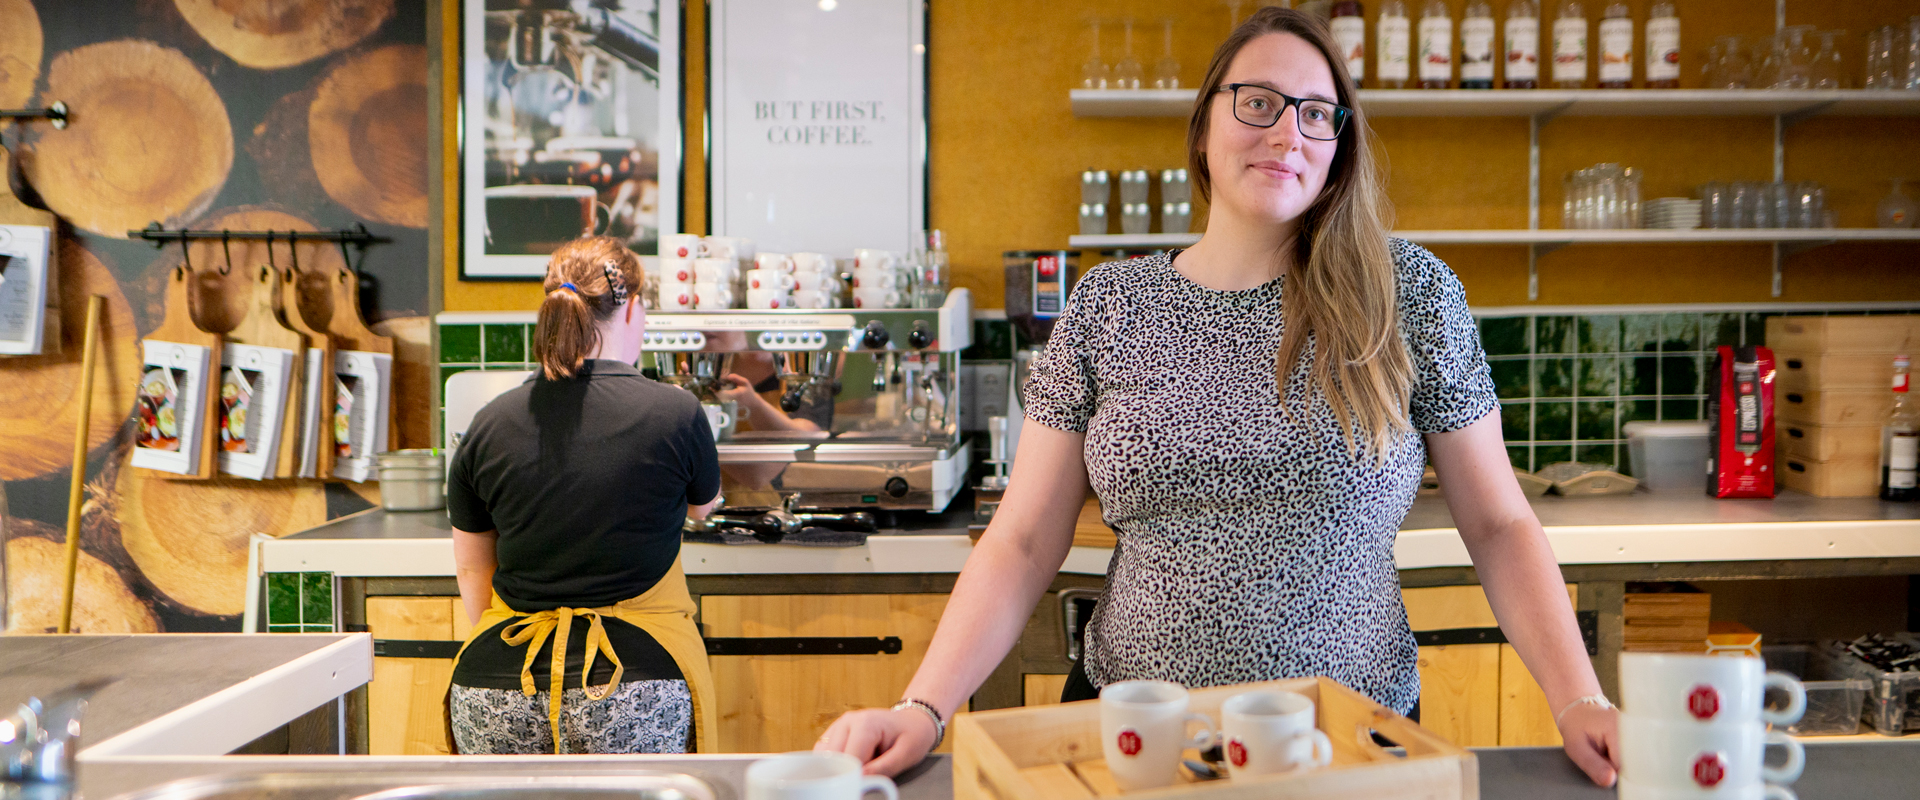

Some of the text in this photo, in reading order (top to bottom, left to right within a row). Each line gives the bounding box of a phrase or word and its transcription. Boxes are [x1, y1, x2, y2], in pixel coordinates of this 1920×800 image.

[755, 100, 886, 122] BUT FIRST,
[767, 125, 873, 144] COFFEE.
